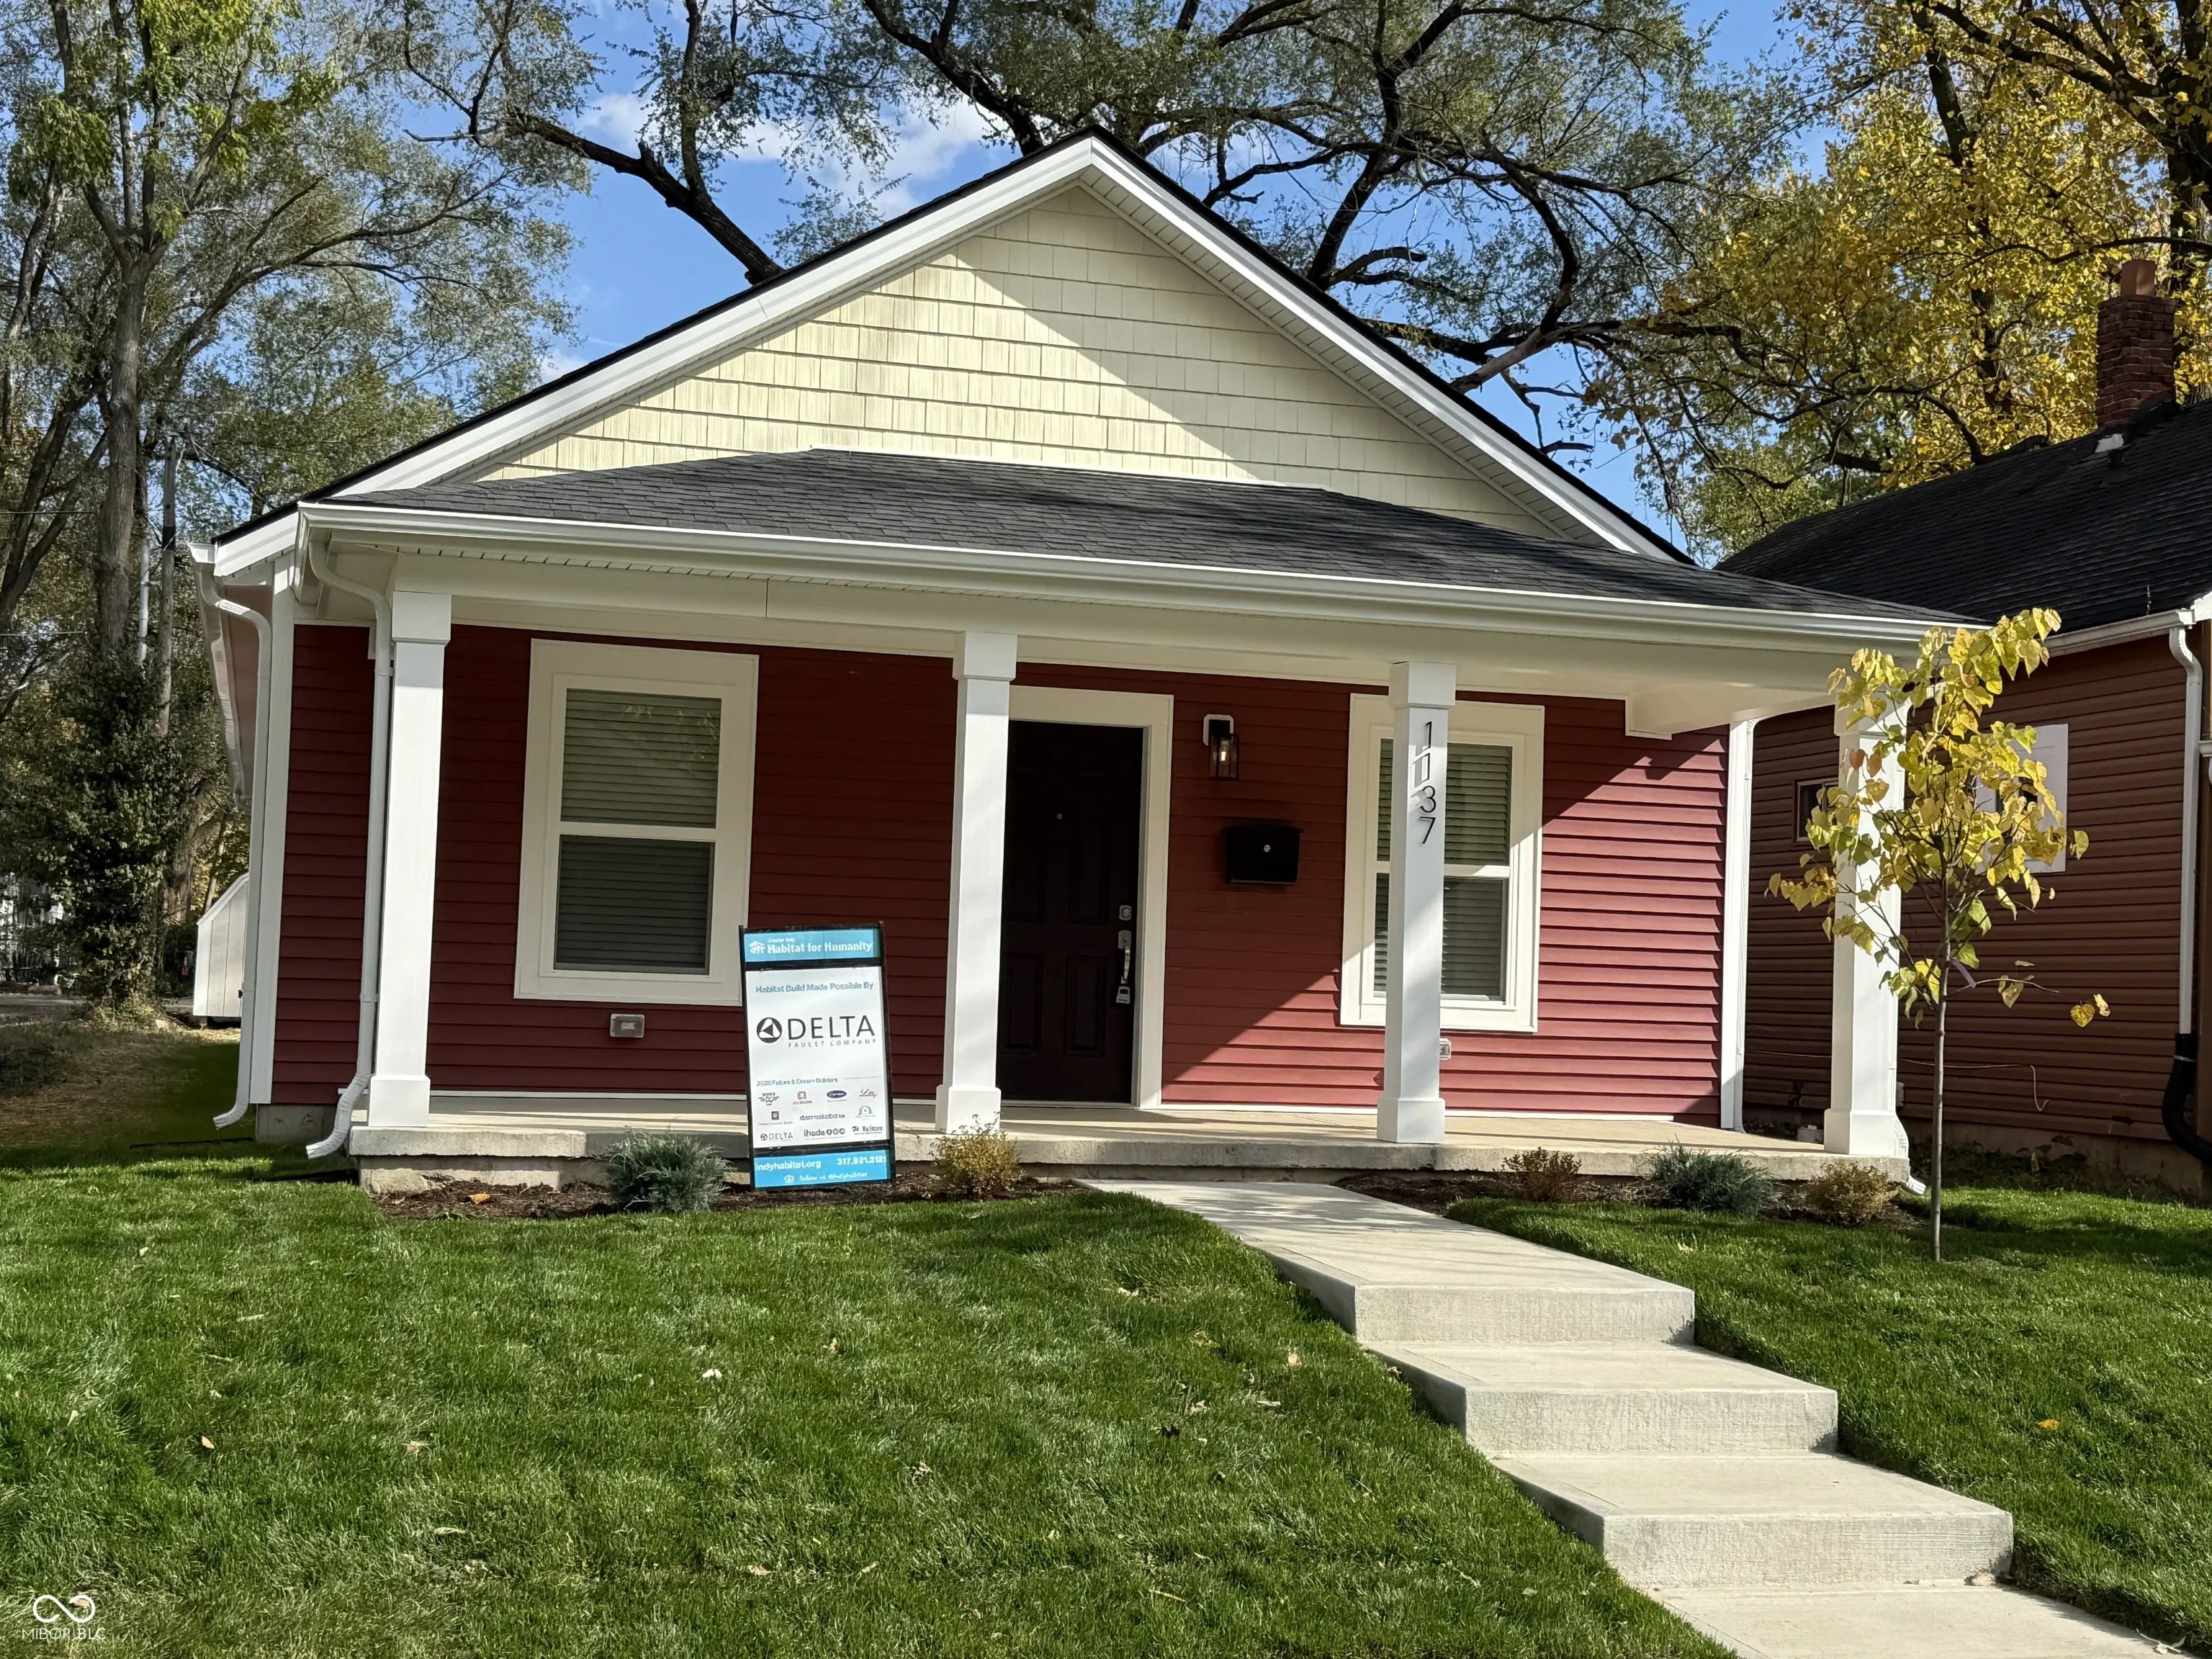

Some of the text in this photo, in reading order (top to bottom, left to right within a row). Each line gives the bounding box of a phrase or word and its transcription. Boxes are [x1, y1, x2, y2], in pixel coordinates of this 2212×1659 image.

[1419, 721, 1437, 844] 1137
[767, 940, 873, 954] Habitat for Humanity
[786, 984, 805, 992] Build
[830, 982, 863, 991] Possible
[863, 981, 874, 990] By
[787, 1015, 876, 1040] DELTA
[830, 1038, 876, 1047] COMPANY
[768, 1132, 793, 1141] DELTA
[755, 1160, 822, 1172] indyhabitat.org
